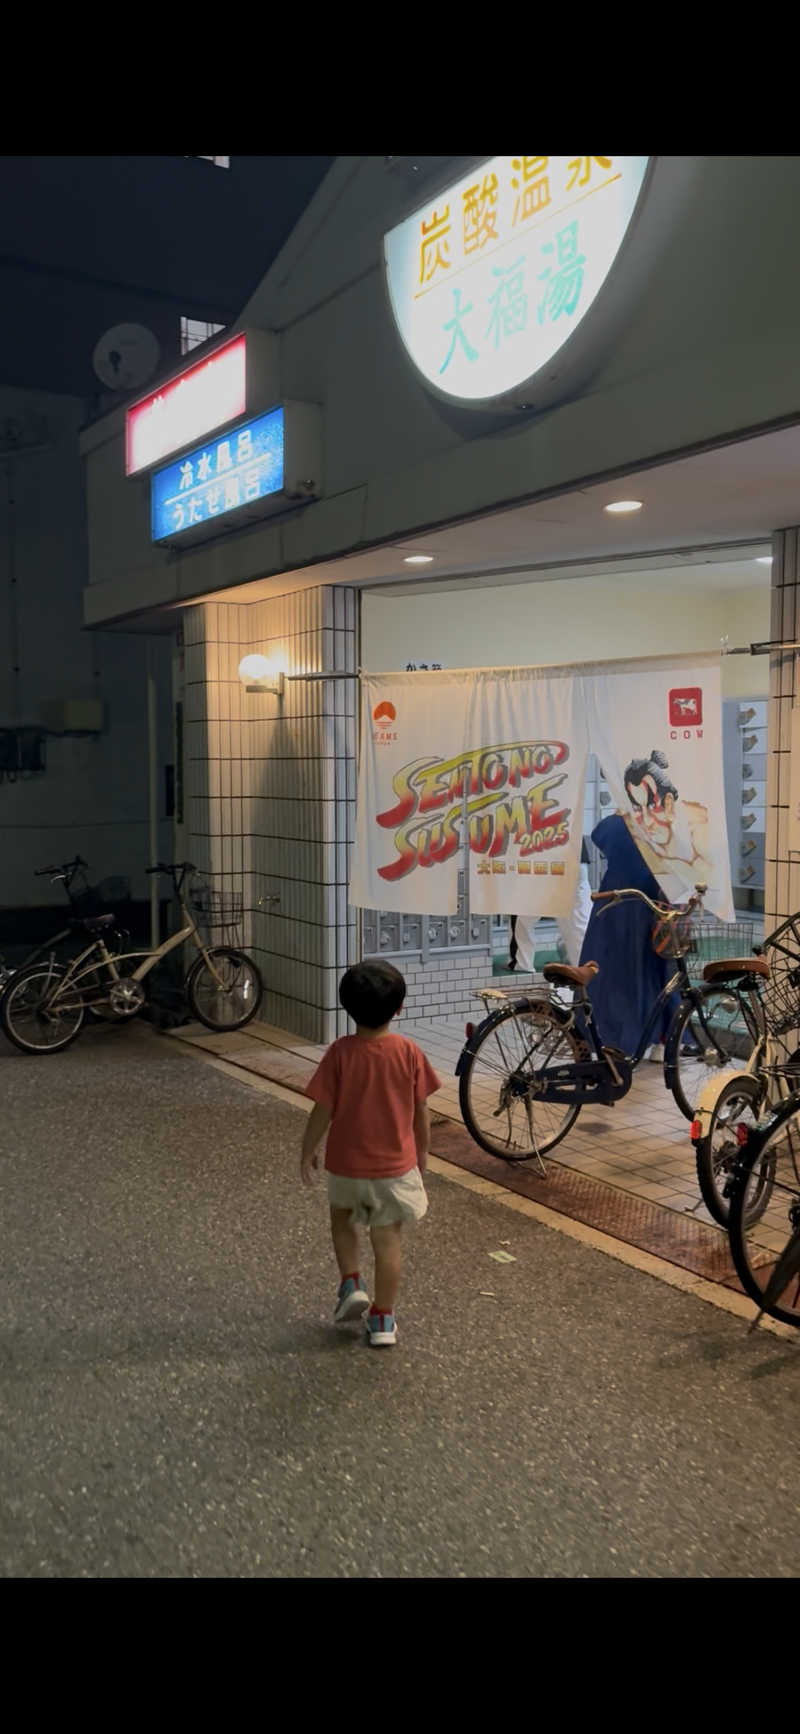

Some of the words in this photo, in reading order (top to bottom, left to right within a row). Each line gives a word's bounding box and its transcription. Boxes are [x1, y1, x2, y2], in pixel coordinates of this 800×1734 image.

[439, 220, 586, 375] 大福湯
[179, 430, 252, 490] 冷水風呂
[172, 468, 261, 530] うたせ風呂
[670, 730, 703, 740] COW
[377, 773, 571, 882] SUSUME
[519, 821, 569, 857] 2025
